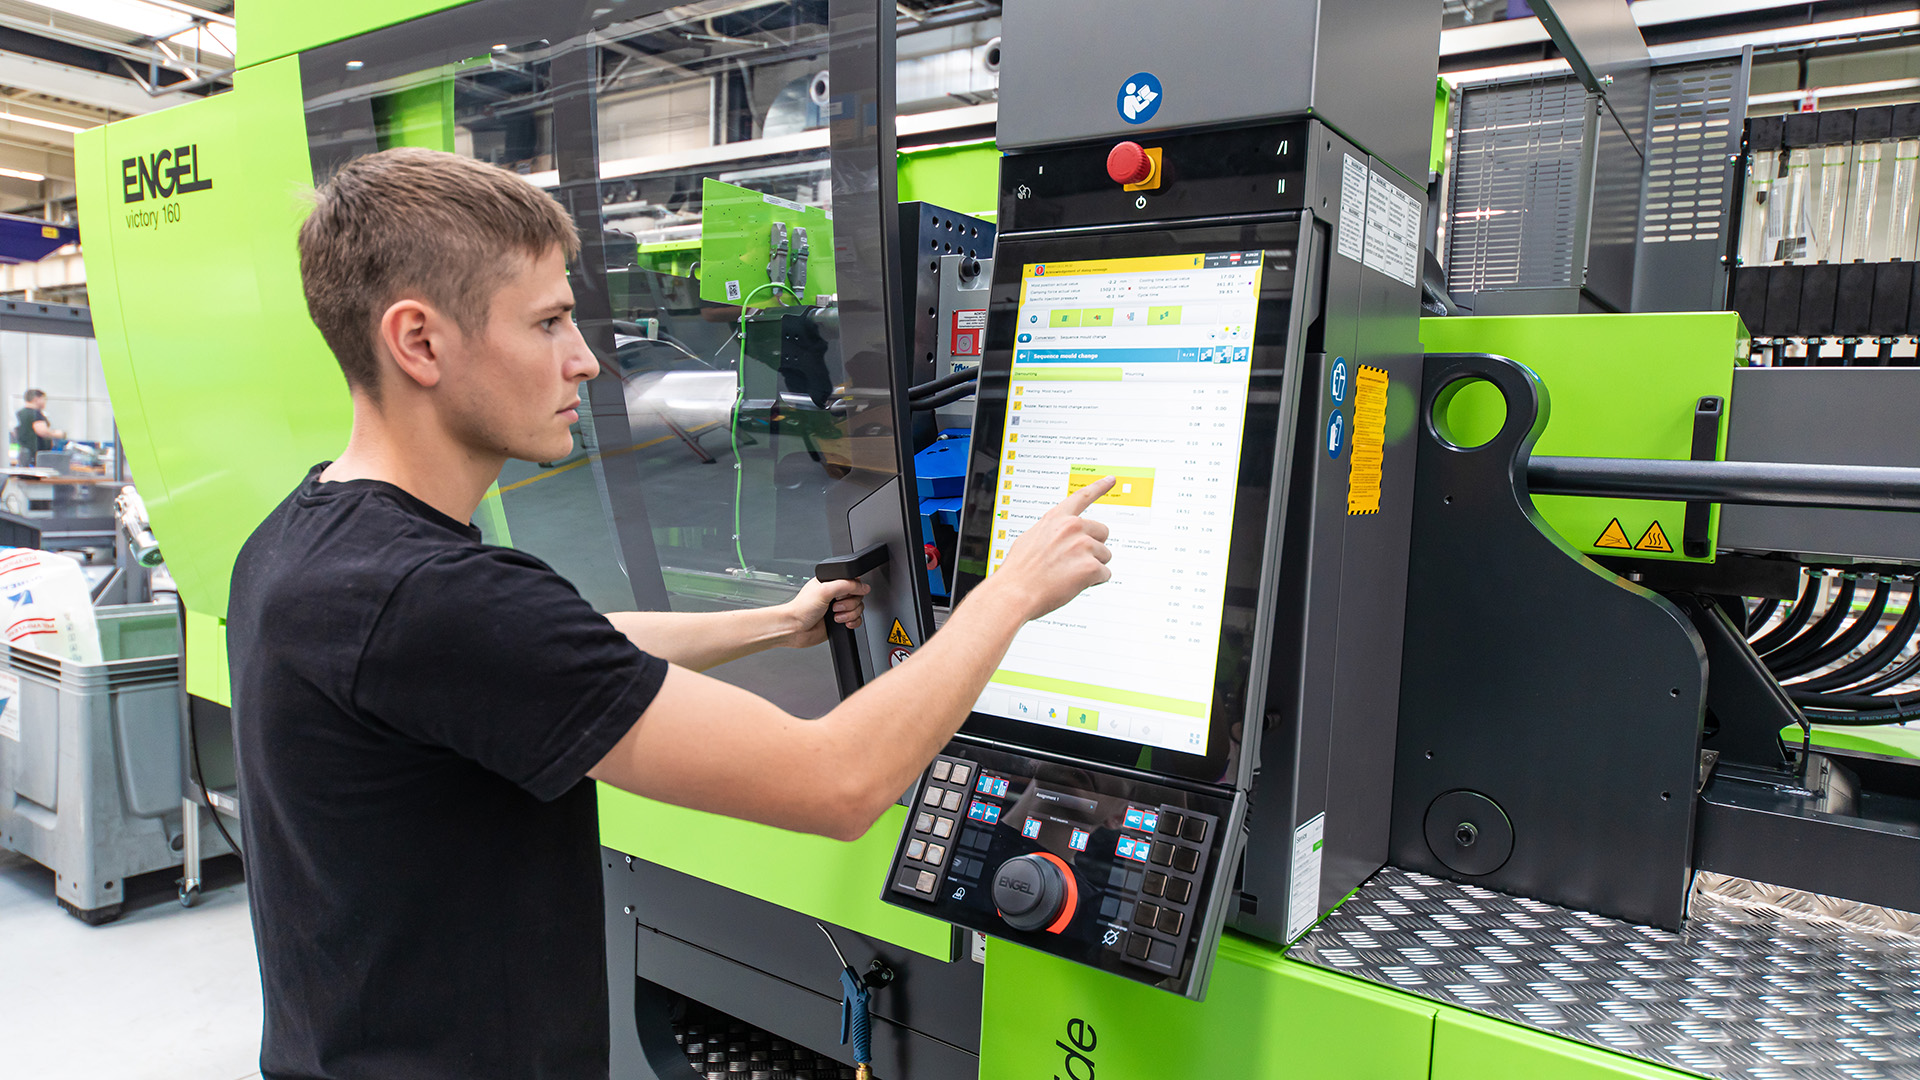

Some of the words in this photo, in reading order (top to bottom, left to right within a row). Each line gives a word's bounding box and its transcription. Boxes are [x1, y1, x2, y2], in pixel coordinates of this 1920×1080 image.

[122, 143, 213, 204] ENGEL
[126, 209, 159, 231] victory
[162, 202, 181, 224] 160
[1078, 352, 1099, 360] change
[1036, 792, 1056, 801] Assignment
[998, 876, 1034, 896] ENGEL
